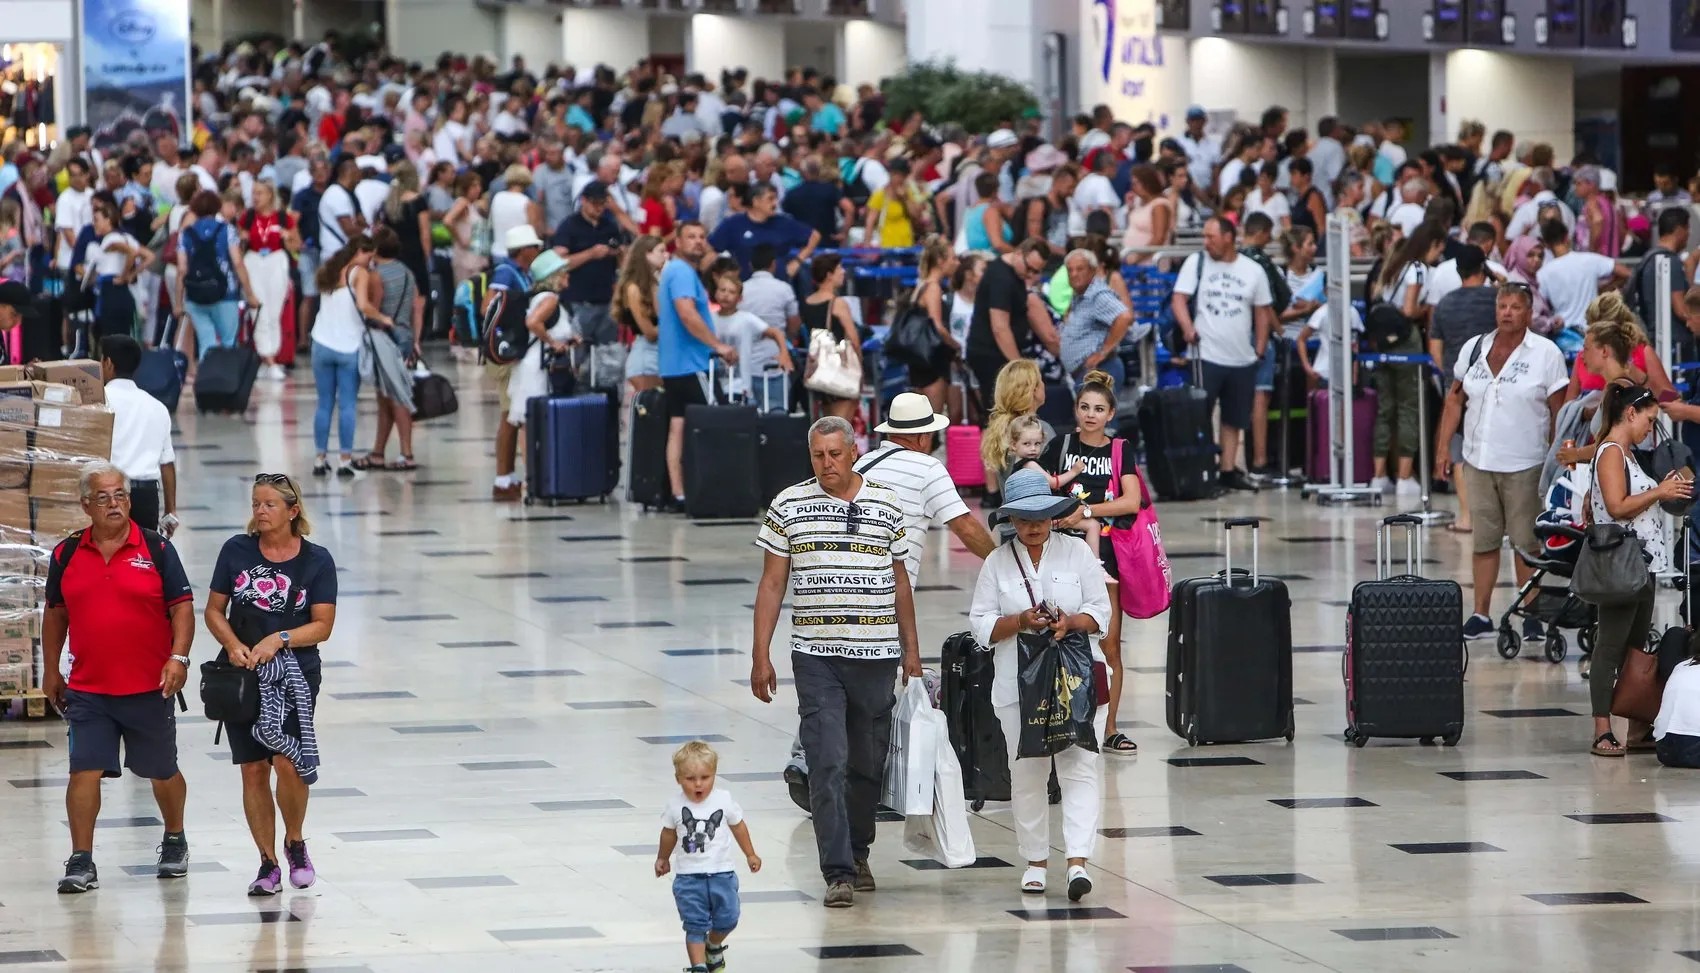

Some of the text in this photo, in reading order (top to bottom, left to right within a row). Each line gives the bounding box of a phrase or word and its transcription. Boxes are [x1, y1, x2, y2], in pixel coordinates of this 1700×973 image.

[796, 504, 871, 516] PUNKTAIC
[850, 543, 888, 556] REASON
[807, 576, 877, 586] PUNKTASTIC
[809, 645, 881, 657] PUNKTASTIC
